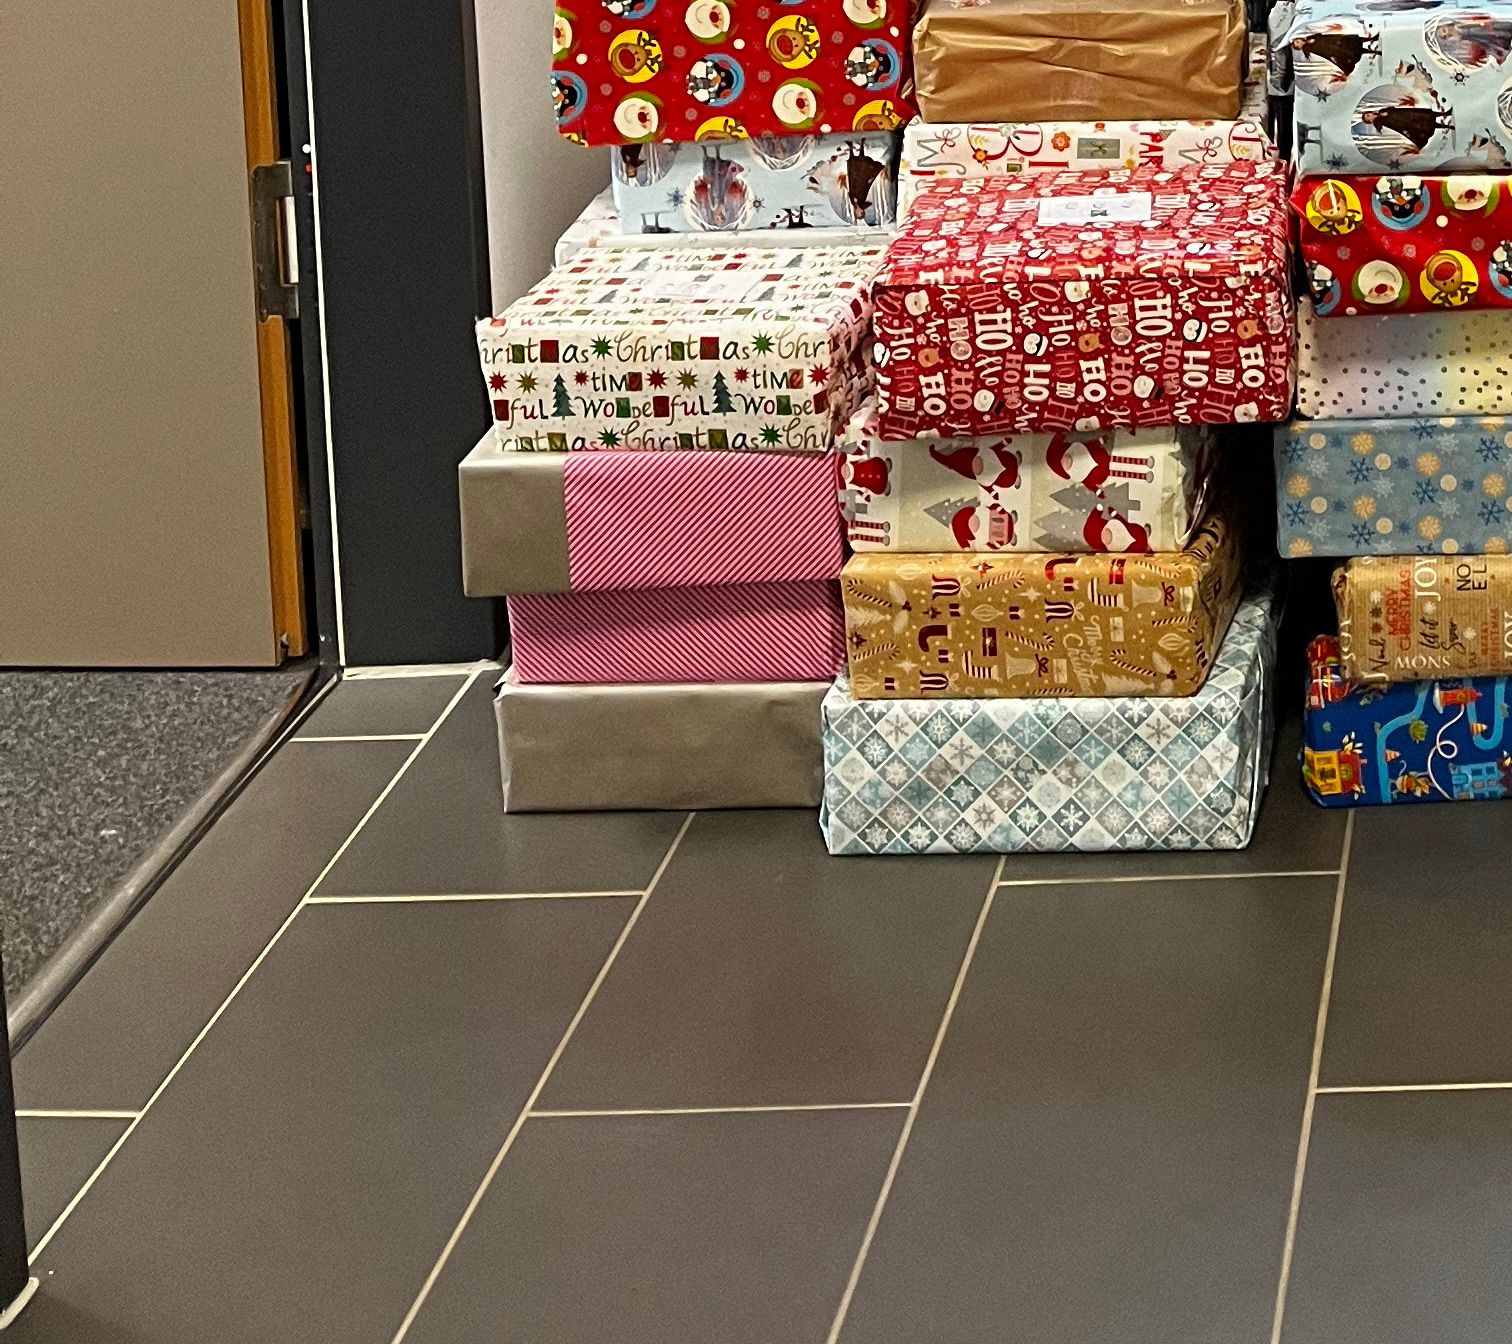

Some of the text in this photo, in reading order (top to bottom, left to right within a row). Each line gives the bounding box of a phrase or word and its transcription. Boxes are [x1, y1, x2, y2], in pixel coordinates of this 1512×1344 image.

[974, 308, 1013, 351] HO
[1134, 294, 1173, 336] HO
[1023, 364, 1051, 402] HO
[1079, 357, 1107, 402] HO
[1111, 353, 1135, 396] HO
[1183, 350, 1211, 388] HO
[1238, 343, 1265, 388] HO
[919, 372, 946, 415] HO
[950, 368, 974, 410] HO
[1414, 556, 1442, 601] JOY
[1393, 655, 1451, 670] SNOW
